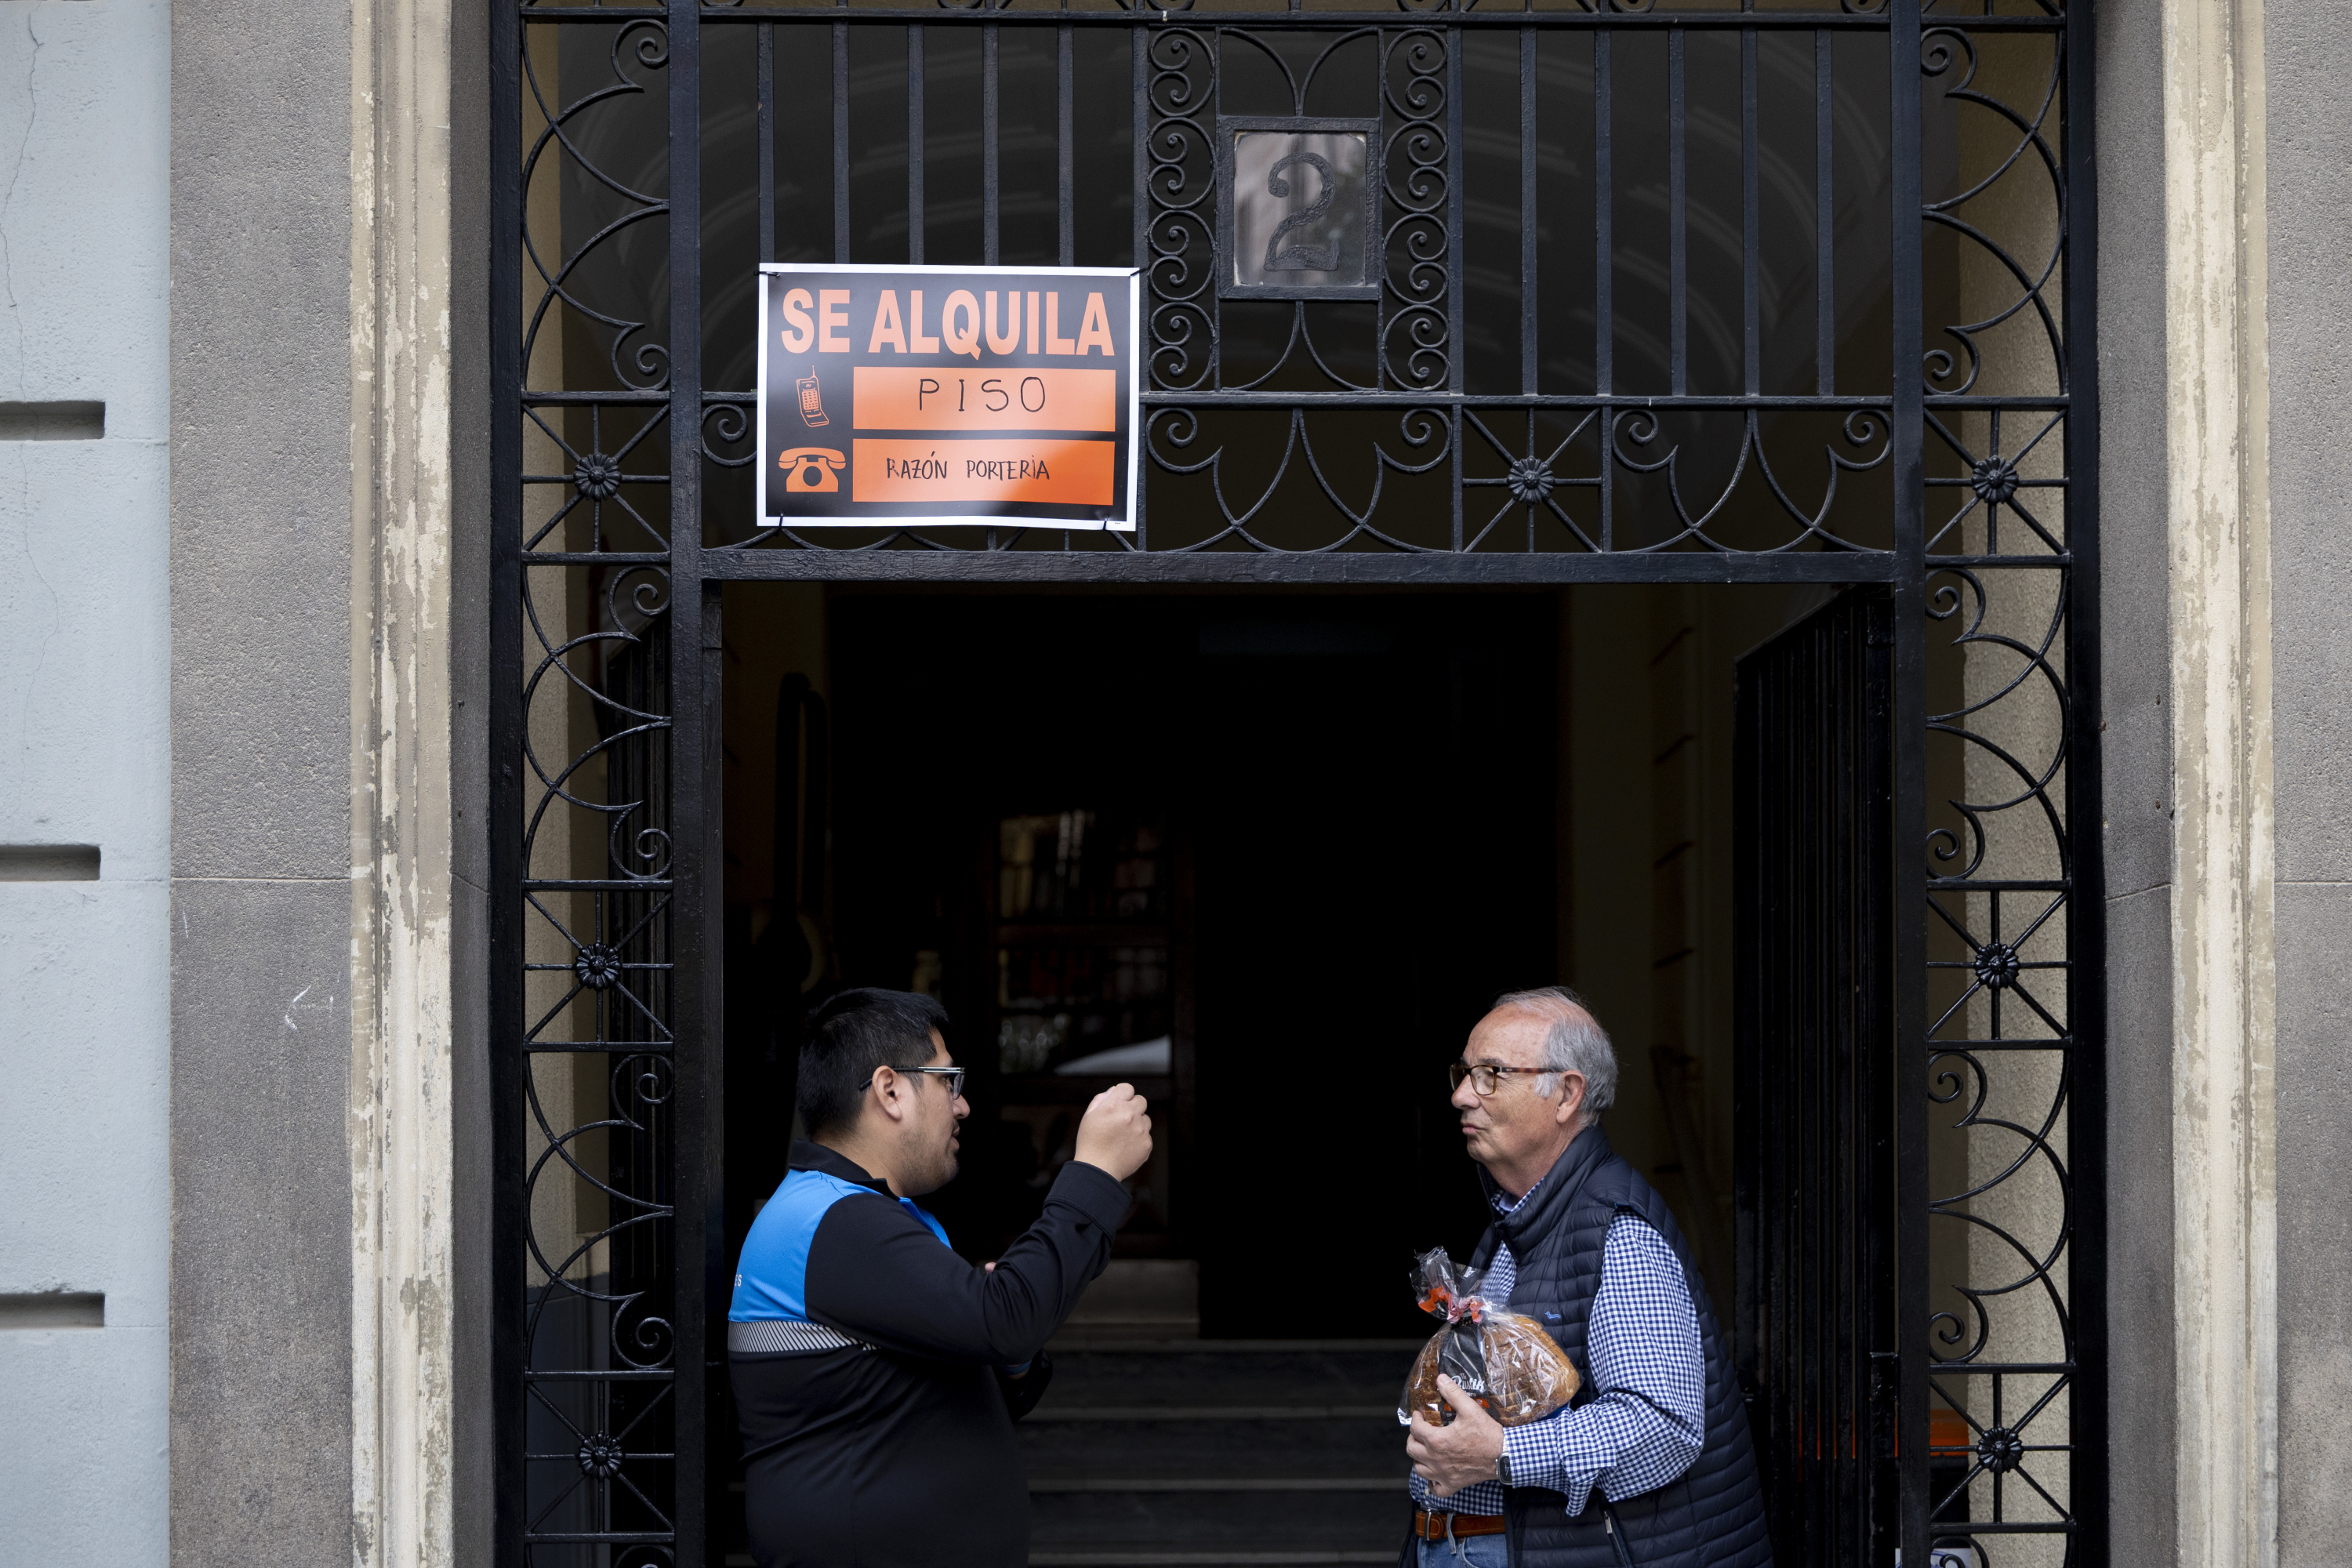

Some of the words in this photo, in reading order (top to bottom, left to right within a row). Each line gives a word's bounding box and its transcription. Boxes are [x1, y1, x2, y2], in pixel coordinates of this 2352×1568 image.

[1264, 152, 1340, 272] 2
[781, 288, 851, 354] SE
[868, 289, 1115, 361] ALQUILA
[919, 376, 1046, 412] PISO
[887, 451, 947, 480] RAZÓN
